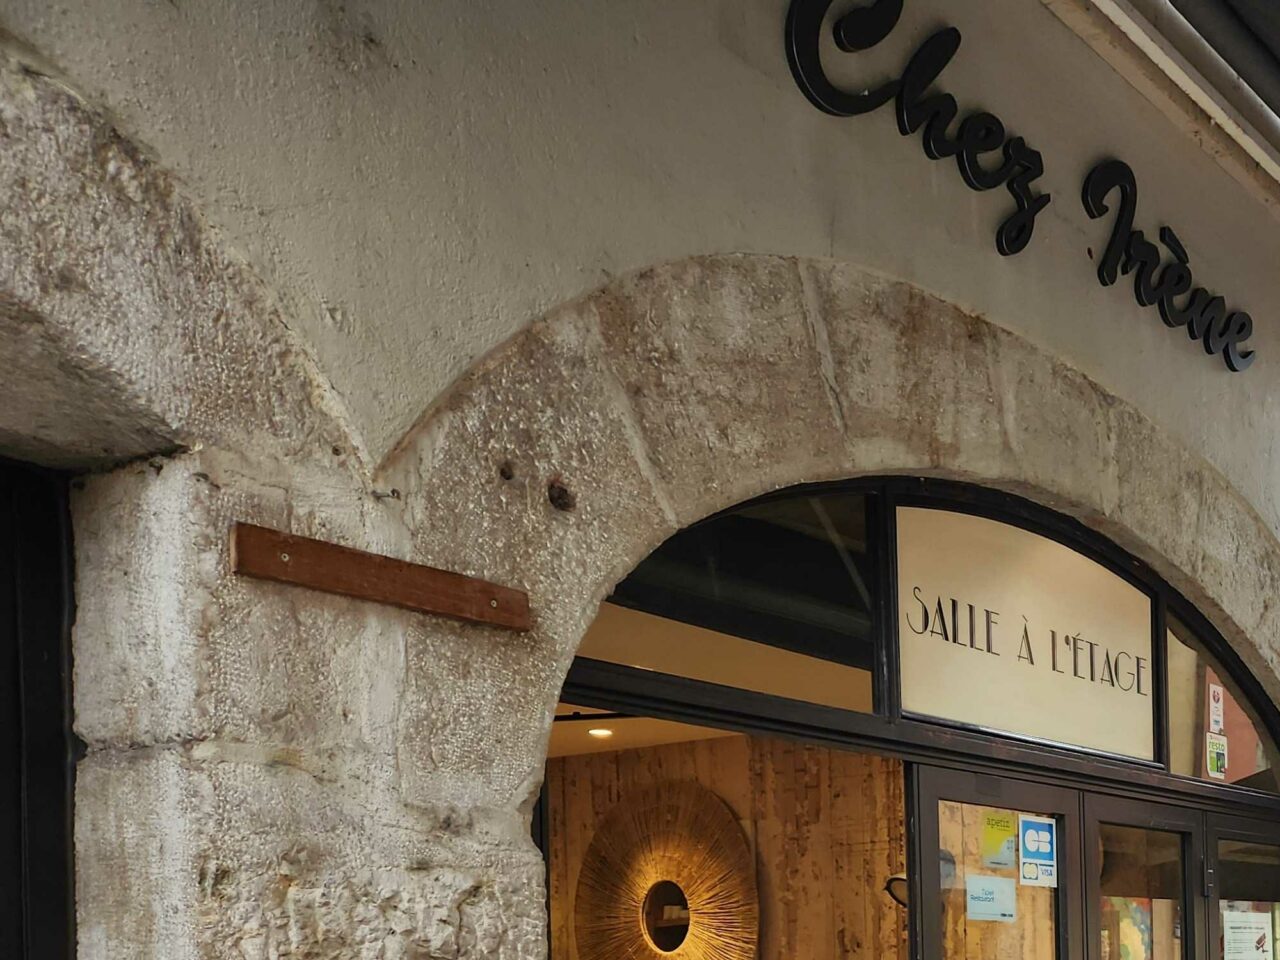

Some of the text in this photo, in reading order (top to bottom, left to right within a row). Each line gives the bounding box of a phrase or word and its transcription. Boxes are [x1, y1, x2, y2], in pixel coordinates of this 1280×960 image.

[785, 0, 1051, 257] Chez
[906, 586, 1149, 697] SALLE À L'ÉTAGE
